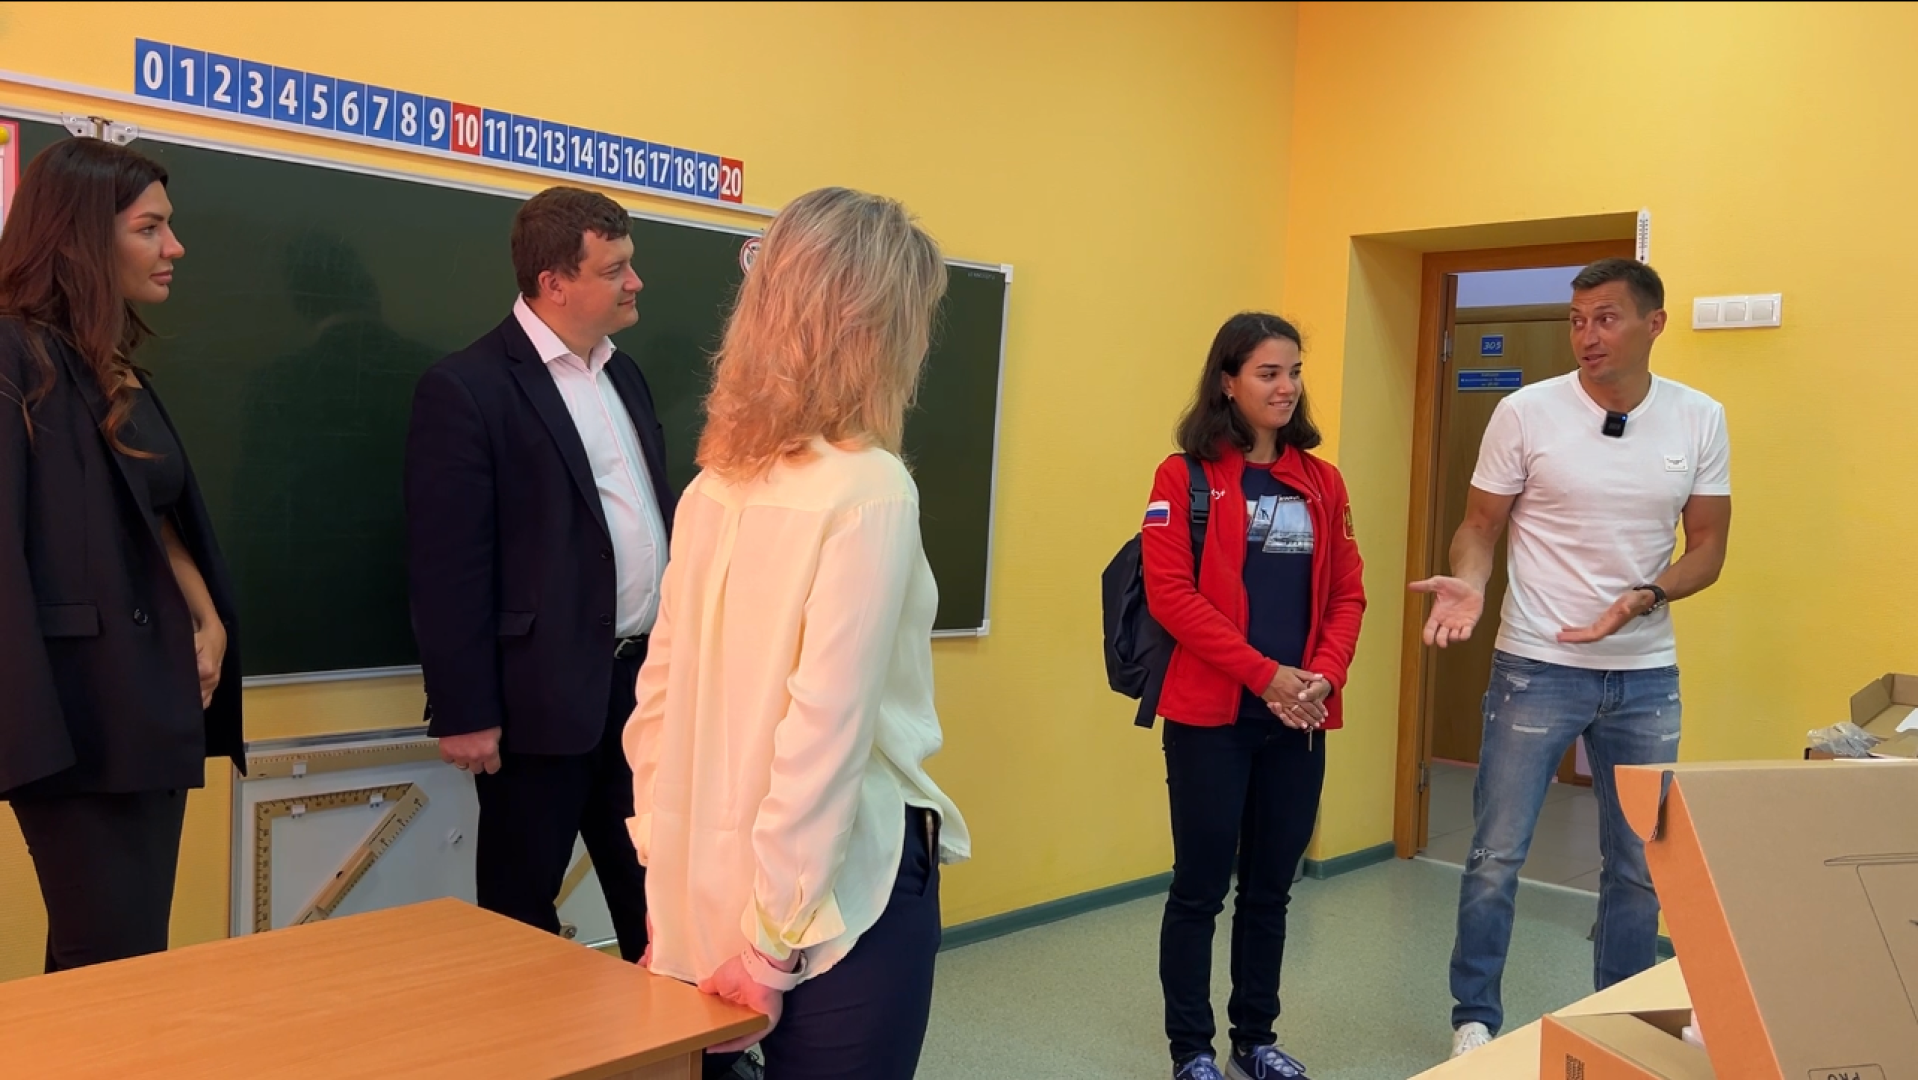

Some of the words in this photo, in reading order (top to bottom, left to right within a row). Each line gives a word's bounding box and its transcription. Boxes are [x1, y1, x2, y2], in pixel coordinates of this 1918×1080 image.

[144, 51, 163, 90] 0
[181, 59, 194, 96] 1
[214, 65, 230, 103] 2
[248, 72, 263, 108] 3
[279, 79, 297, 115] 4
[312, 84, 327, 119] 5
[342, 91, 358, 125] 6
[373, 96, 388, 130] 7
[401, 102, 417, 136] 8
[430, 108, 445, 140] 9
[455, 113, 478, 148] 10
[485, 119, 507, 153] 11
[515, 125, 537, 159] 12
[544, 130, 565, 163] 13
[571, 136, 593, 169] 14
[599, 142, 619, 173] 15
[625, 146, 645, 179] 16
[650, 152, 669, 183] 17
[675, 157, 695, 188] 18
[699, 161, 718, 191] 19
[722, 166, 741, 197] 20
